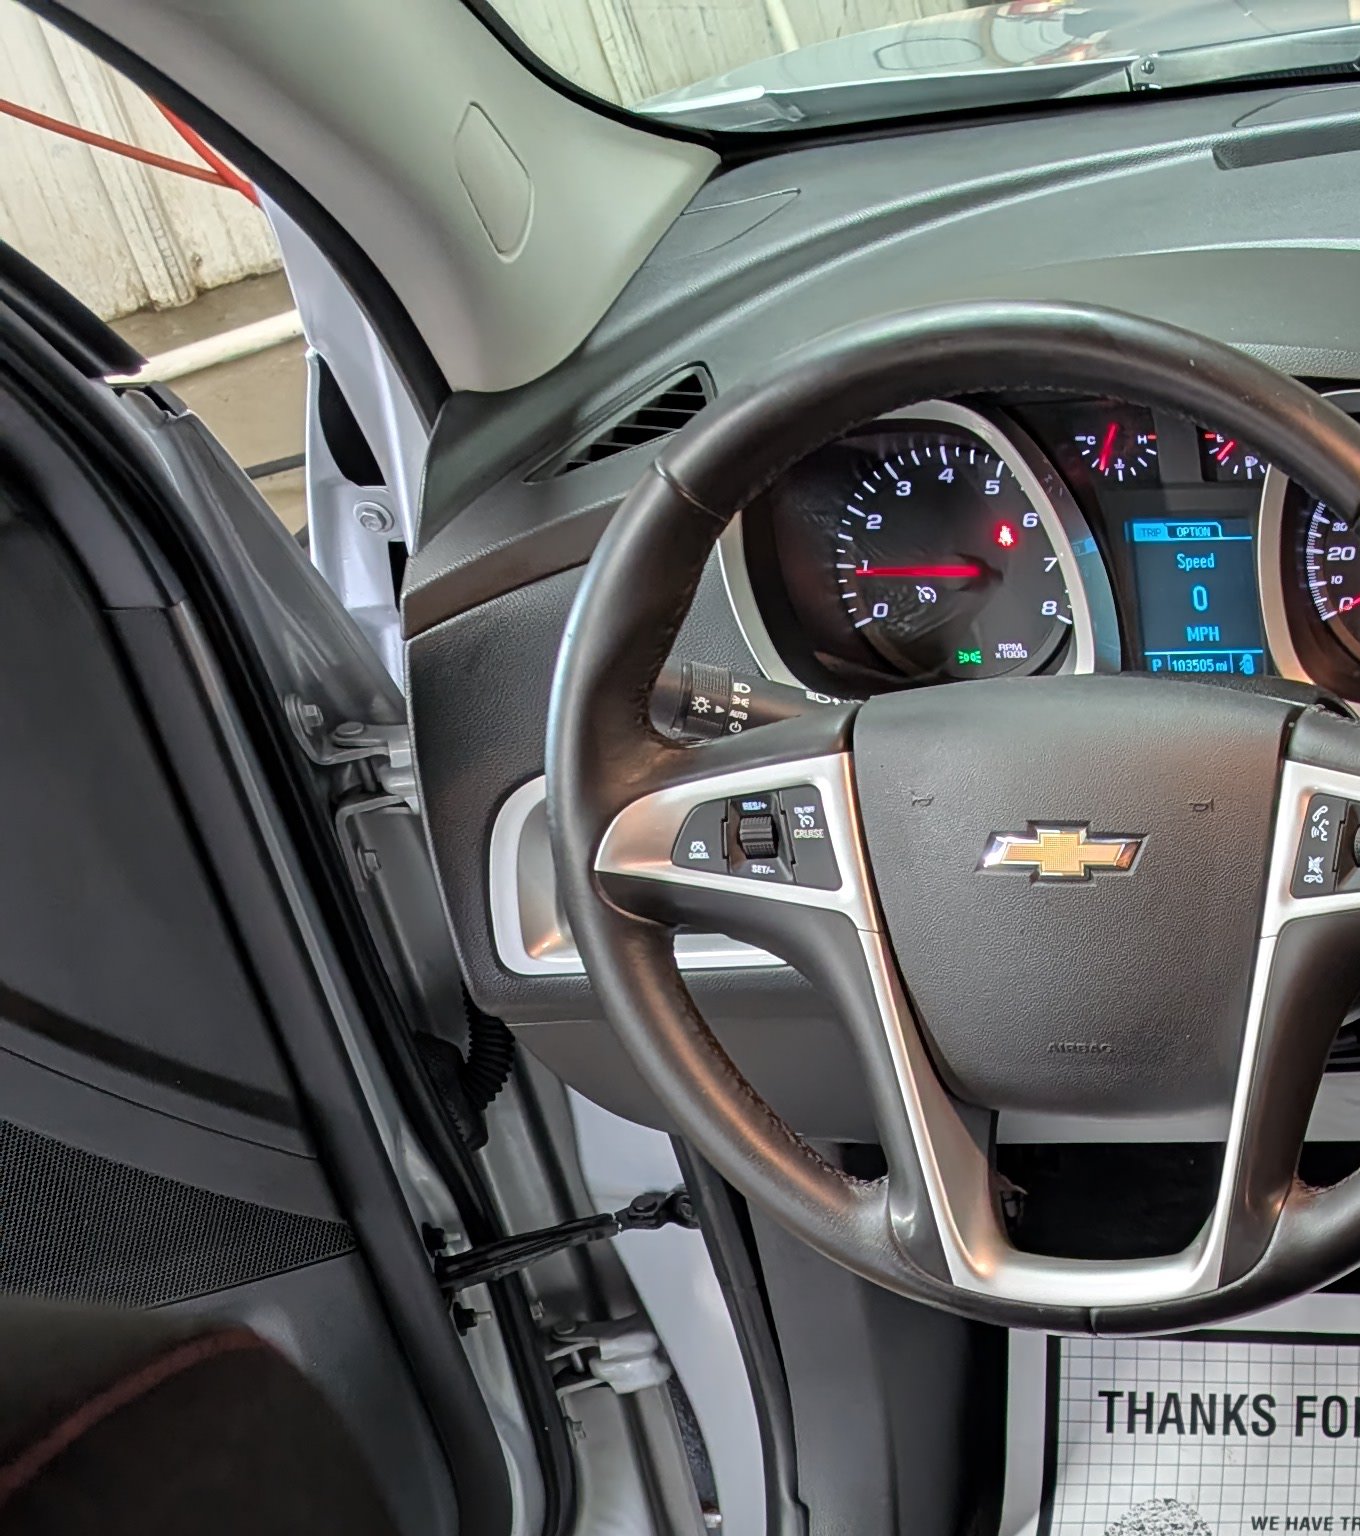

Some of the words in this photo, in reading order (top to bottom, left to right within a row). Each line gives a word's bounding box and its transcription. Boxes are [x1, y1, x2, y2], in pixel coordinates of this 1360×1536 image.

[938, 467, 954, 483] 4
[895, 481, 911, 496] 3
[984, 480, 1000, 496] 5
[866, 515, 882, 530] 2
[1023, 513, 1039, 528] 6
[1176, 526, 1211, 537] OPTION
[1326, 546, 1356, 561] 20
[1044, 557, 1058, 572] 7
[1176, 553, 1215, 572] Speed
[1331, 576, 1343, 585] 10
[1192, 585, 1209, 612] 0
[872, 603, 888, 618] 0
[1041, 600, 1057, 616] 8
[1186, 626, 1220, 642] MPH
[998, 643, 1023, 652] RPM
[1152, 659, 1162, 672] P
[1172, 658, 1215, 672] 103505
[729, 709, 748, 720] AUTO
[793, 829, 825, 839] CRUISE
[1098, 1390, 1277, 1438] THANKS
[1251, 1516, 1279, 1531] WE
[1285, 1516, 1334, 1532] HAVE
